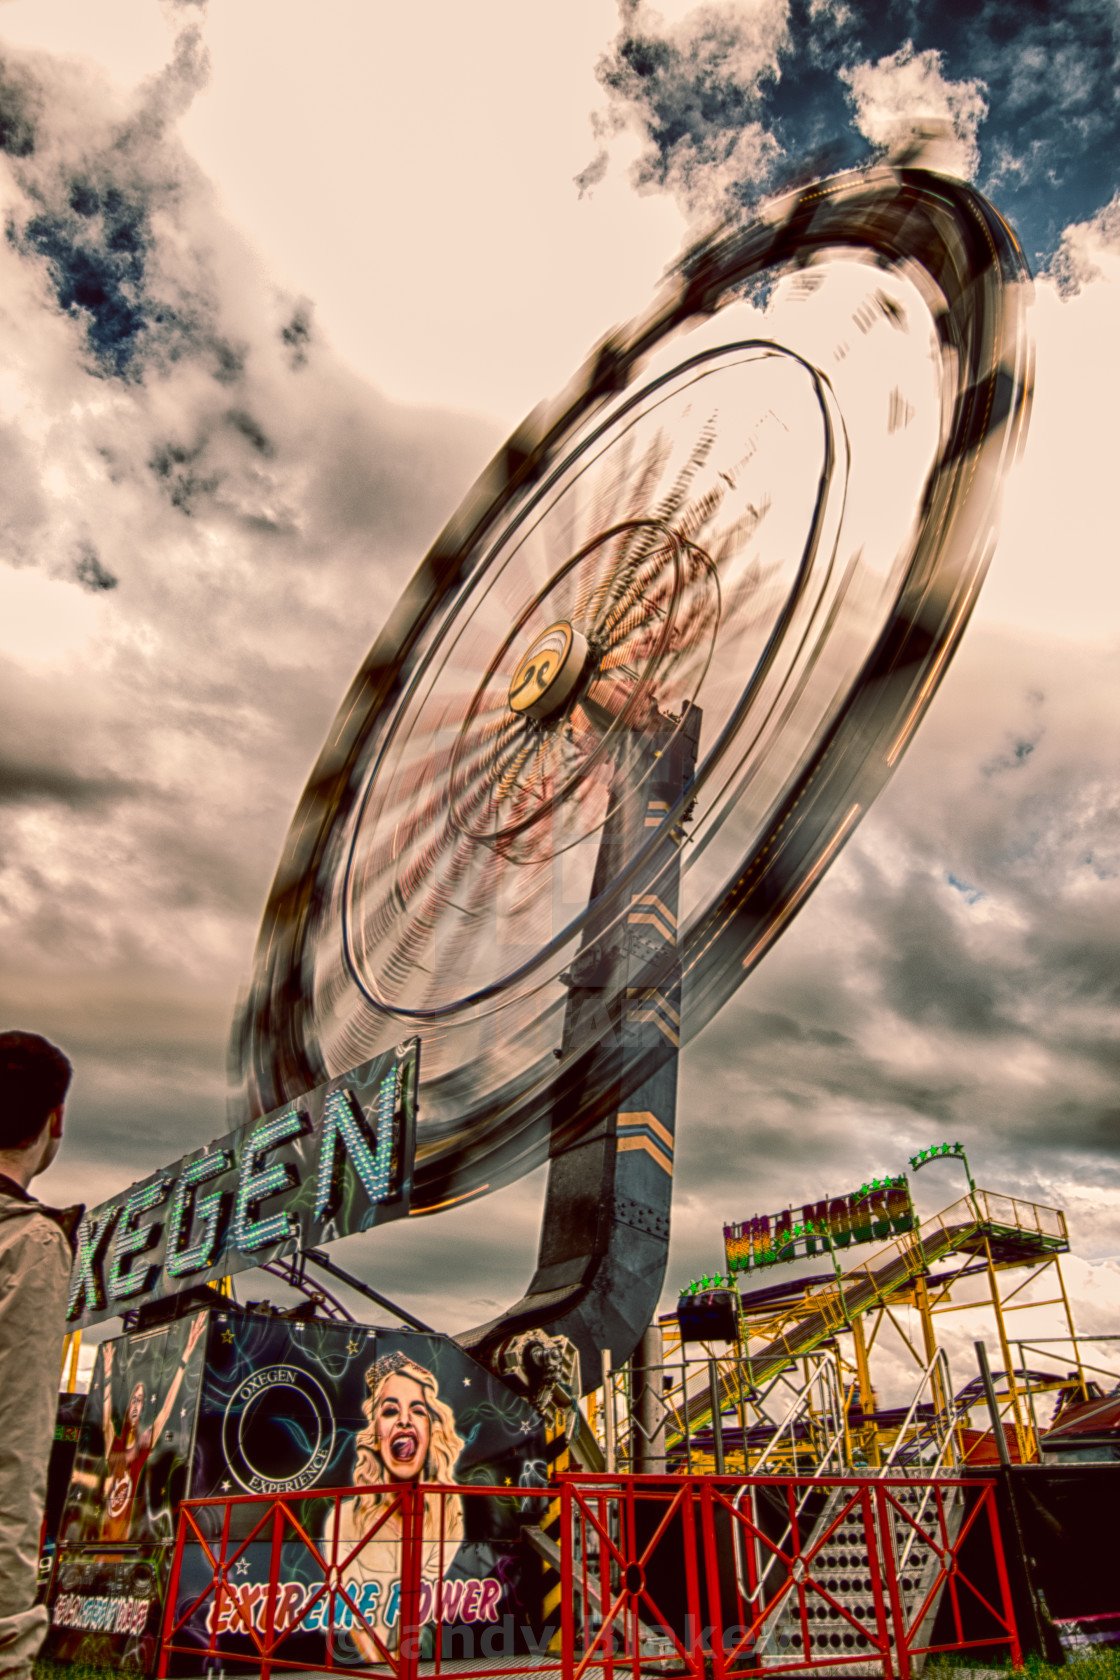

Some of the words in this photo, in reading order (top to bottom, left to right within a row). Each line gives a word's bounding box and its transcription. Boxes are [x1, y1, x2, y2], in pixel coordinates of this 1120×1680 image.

[66, 1062, 398, 1320] XEGEN
[803, 1189, 914, 1256] MOUSE
[240, 1370, 298, 1400] OXEGEN
[248, 1448, 328, 1494] EXPERIENCE
[205, 1582, 380, 1634] EXTREME
